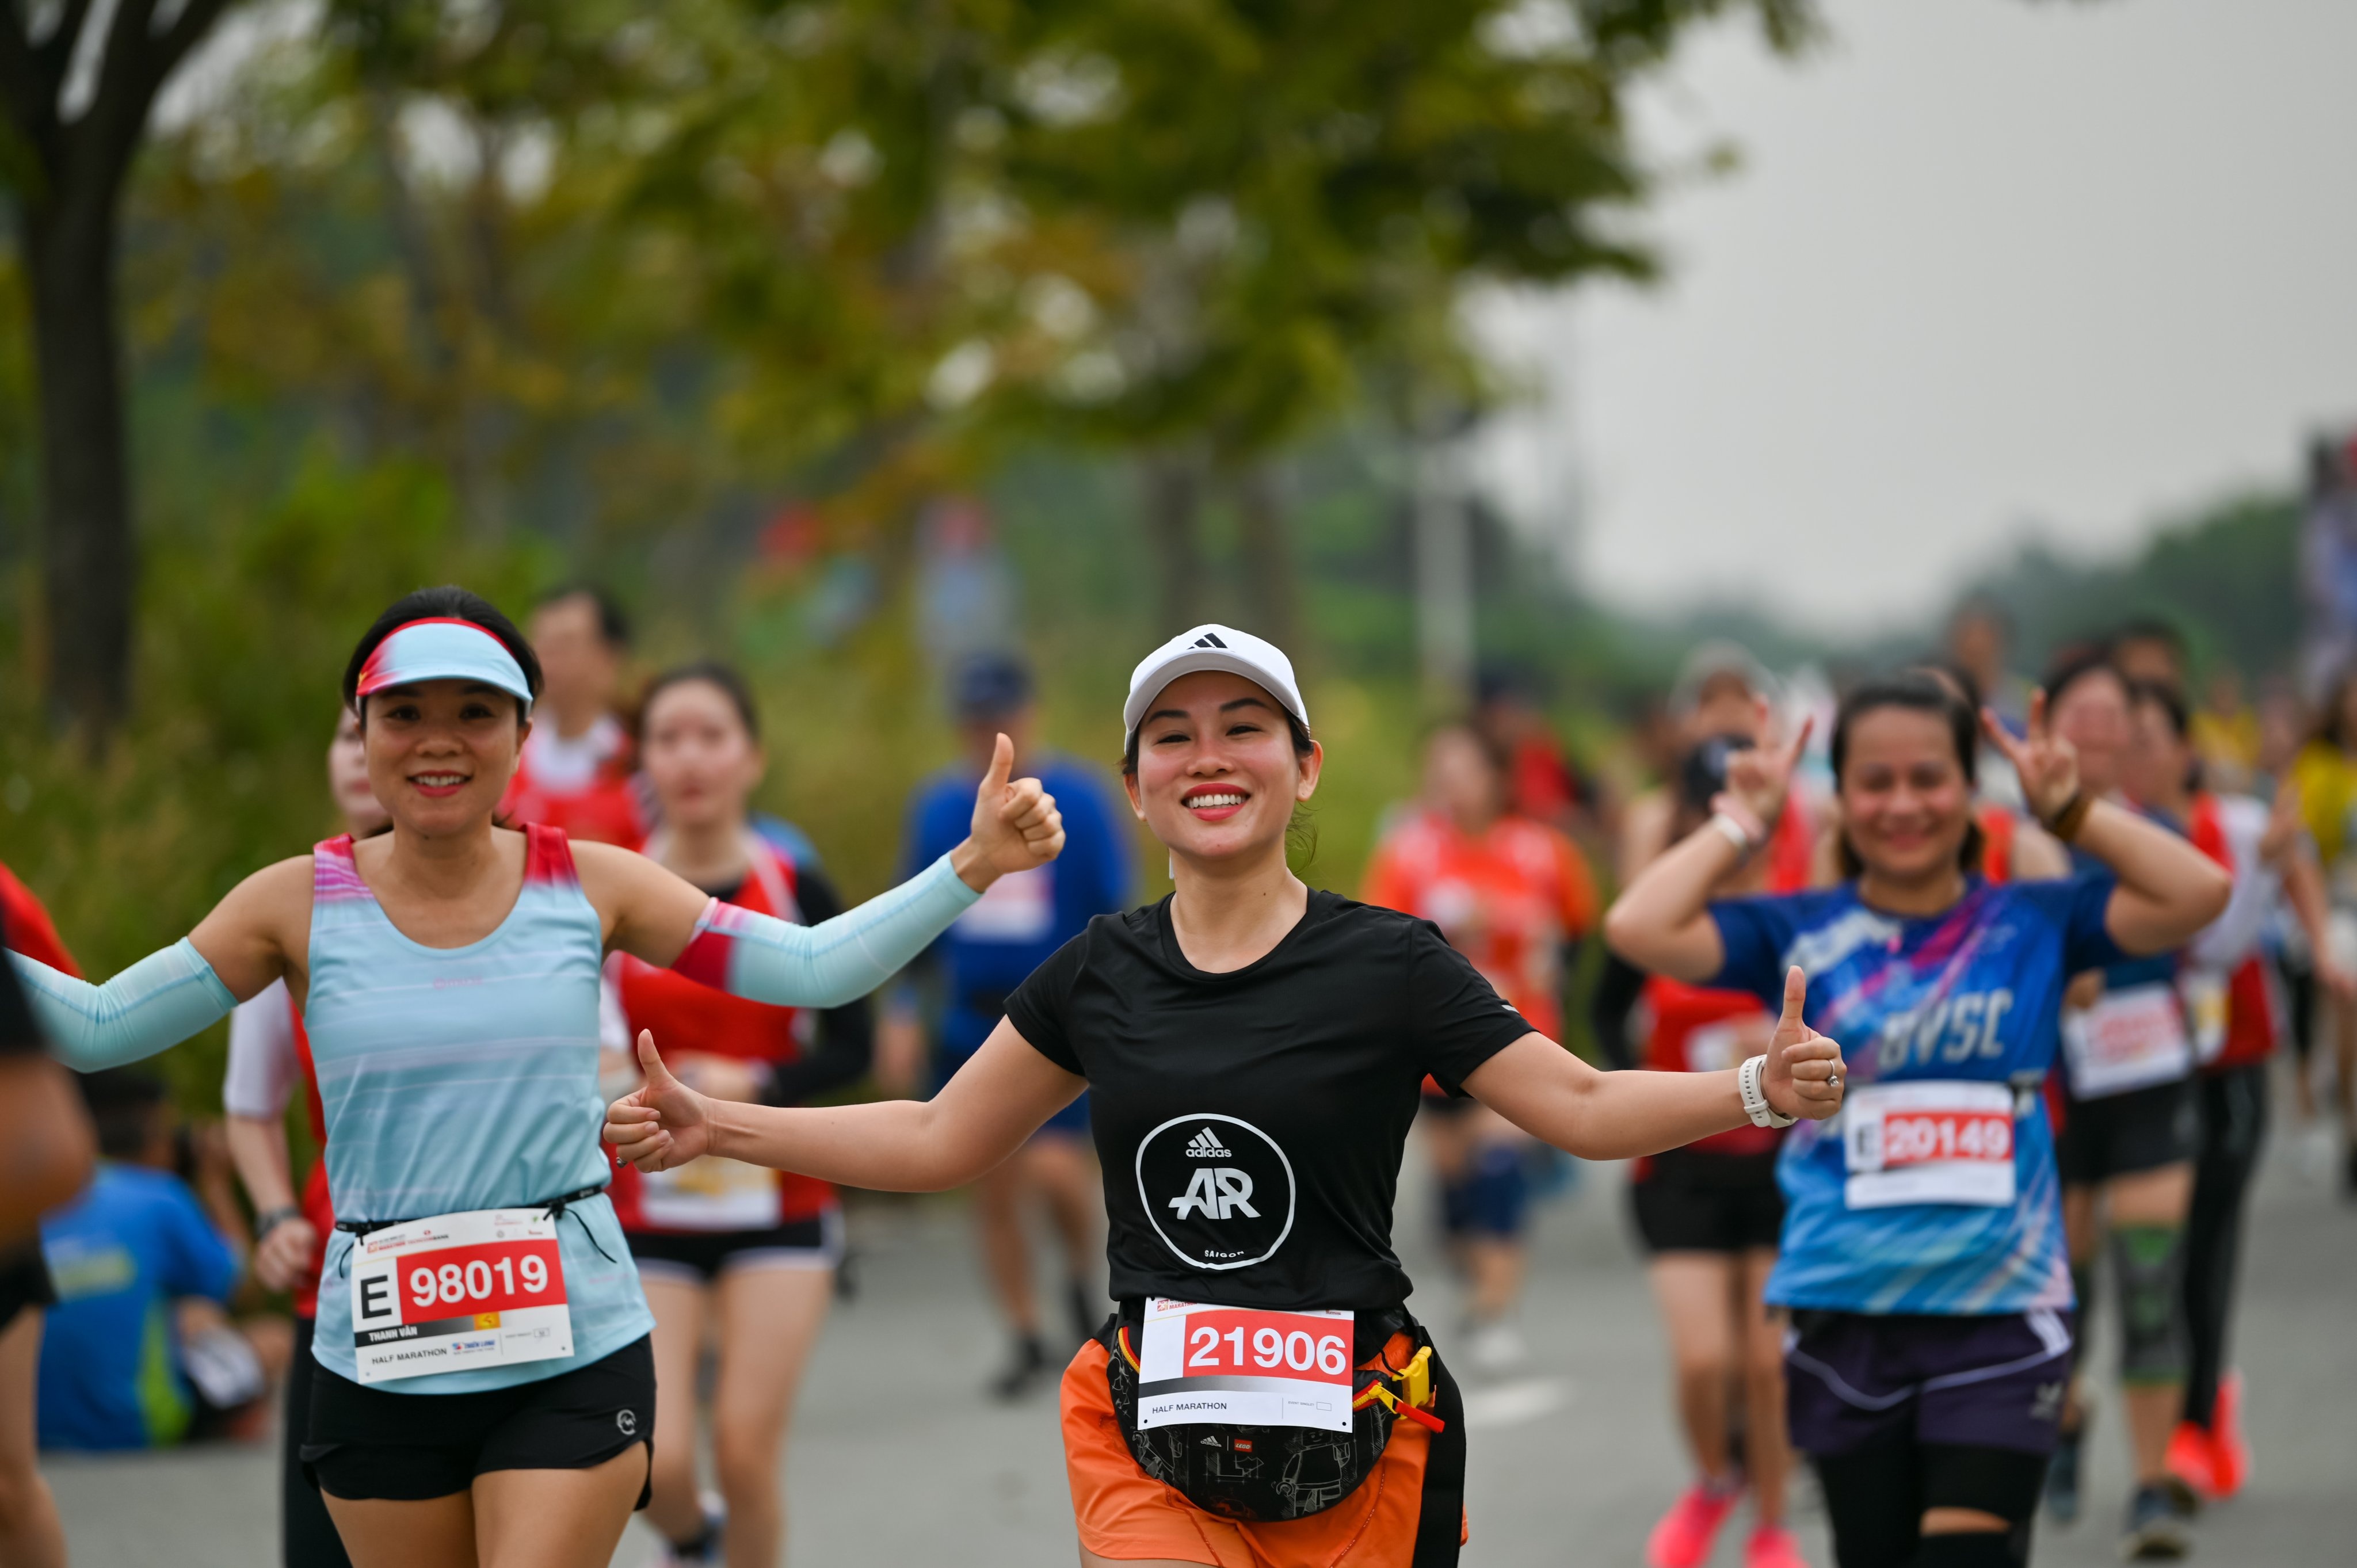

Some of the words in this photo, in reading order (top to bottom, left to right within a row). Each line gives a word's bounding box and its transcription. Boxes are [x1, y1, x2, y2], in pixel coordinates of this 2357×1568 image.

[1885, 1116, 2010, 1158] 20149
[1185, 1147, 1232, 1158] adidas
[1168, 1168, 1262, 1220] AR
[1204, 1250, 1245, 1258] SAIGON
[360, 1275, 392, 1319] E
[410, 1254, 548, 1307] 98019
[368, 1329, 398, 1342] THANH
[372, 1355, 394, 1365] HALF
[397, 1348, 448, 1361] MARATHON
[1188, 1326, 1347, 1376] 21906
[1152, 1405, 1174, 1414] HALF
[1176, 1402, 1227, 1410] MARATHON
[1200, 1440, 1222, 1448] adidas
